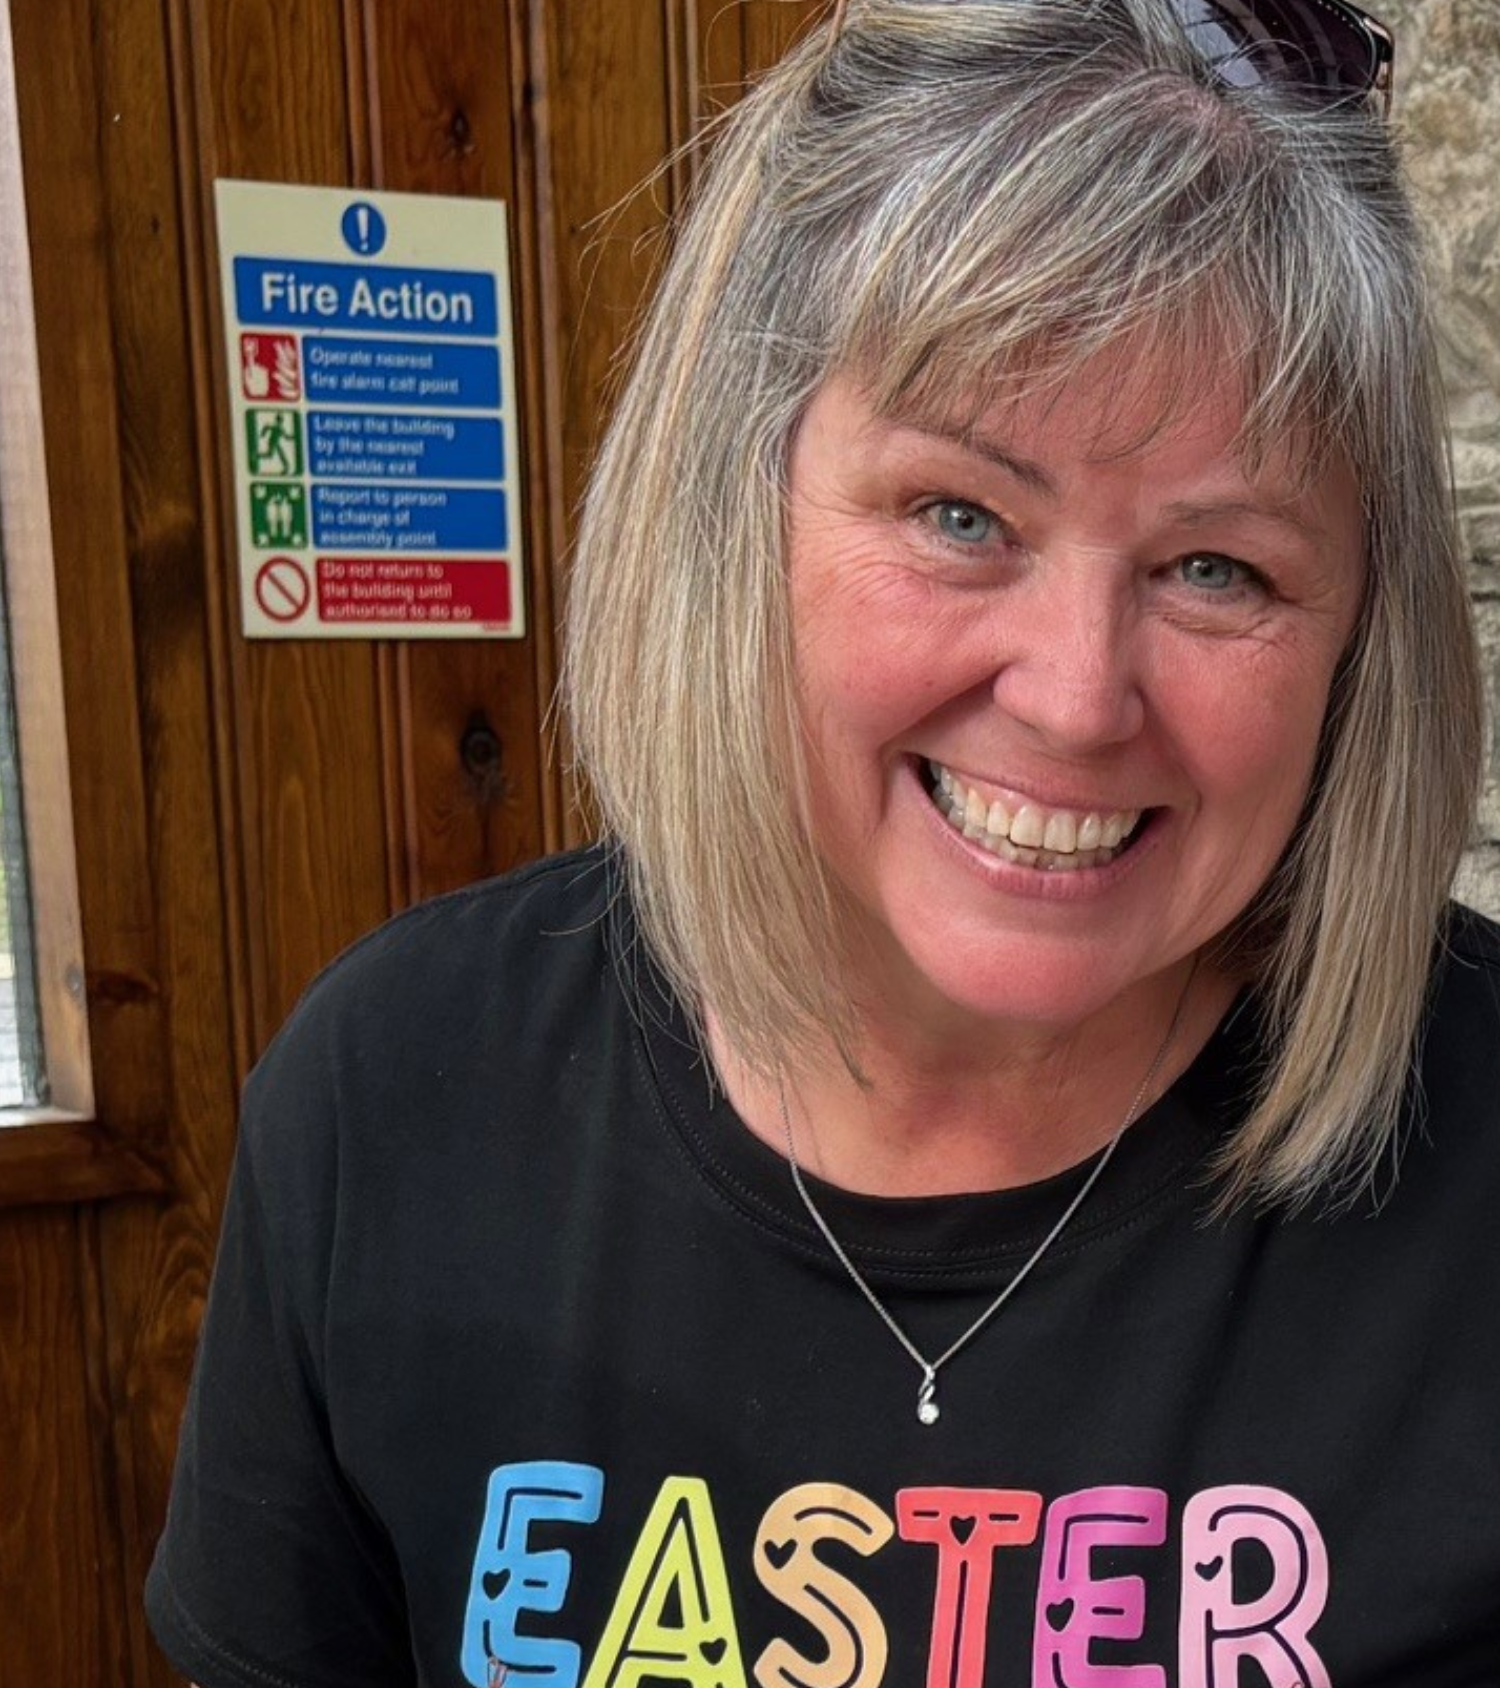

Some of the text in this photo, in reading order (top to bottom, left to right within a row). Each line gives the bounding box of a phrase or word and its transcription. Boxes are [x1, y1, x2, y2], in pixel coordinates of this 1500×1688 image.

[261, 271, 474, 324] Fire Action
[310, 347, 433, 369] Operate nearest
[310, 372, 459, 395] fire alarm call point
[314, 415, 455, 441] Leave the building
[315, 437, 425, 456] by the nearest
[317, 457, 417, 474] available exit
[318, 487, 447, 508] Report to person
[319, 509, 411, 527] in charge of
[320, 530, 437, 548] assembly point
[322, 562, 443, 580] Do not return to
[324, 582, 453, 604] the building until
[410, 604, 425, 618] to
[428, 604, 449, 618] do
[452, 605, 473, 618] so
